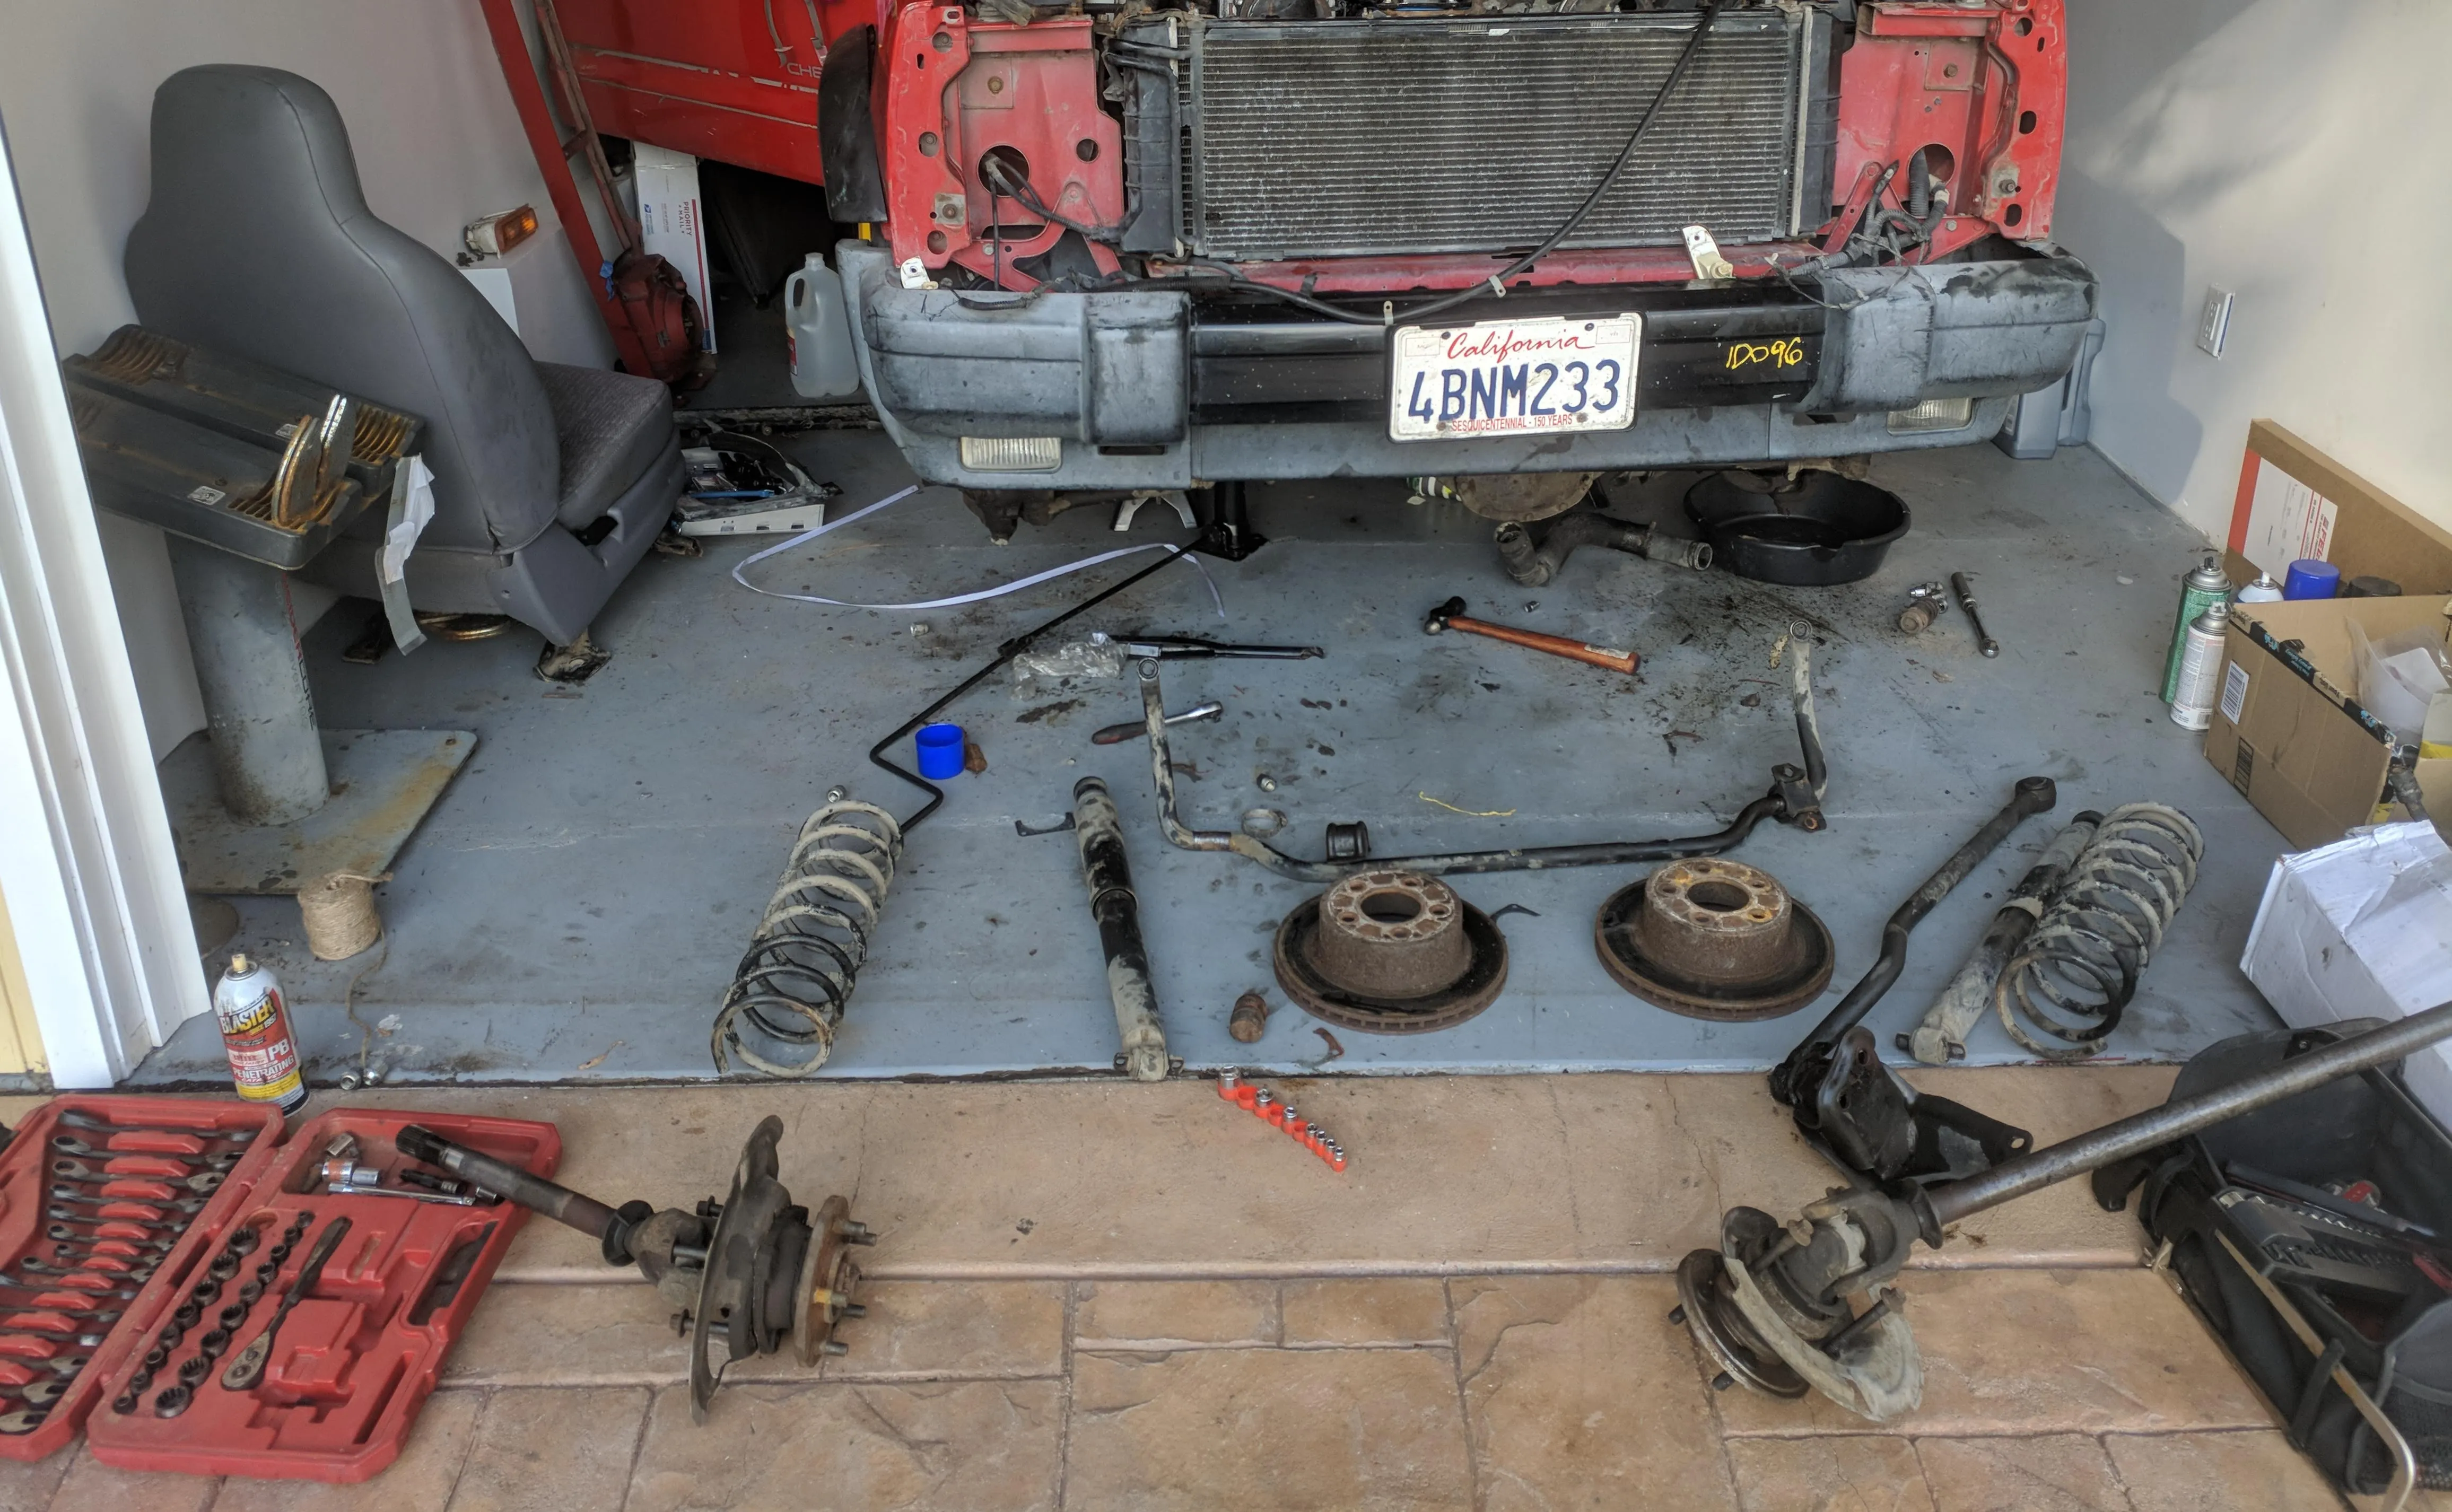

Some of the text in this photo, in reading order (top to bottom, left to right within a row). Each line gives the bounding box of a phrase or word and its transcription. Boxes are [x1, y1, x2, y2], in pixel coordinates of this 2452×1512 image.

[683, 202, 692, 235] PRIORITY
[1447, 329, 1595, 364] California
[1408, 359, 1620, 424] 4BNM233
[1451, 417, 1527, 432] SESQUICENTENNIAL
[1533, 416, 1546, 427] 150
[1548, 414, 1572, 426] YEARS
[220, 995, 276, 1034] BLASTER
[268, 1038, 290, 1061] PB
[232, 1055, 294, 1079] PENETRATING
